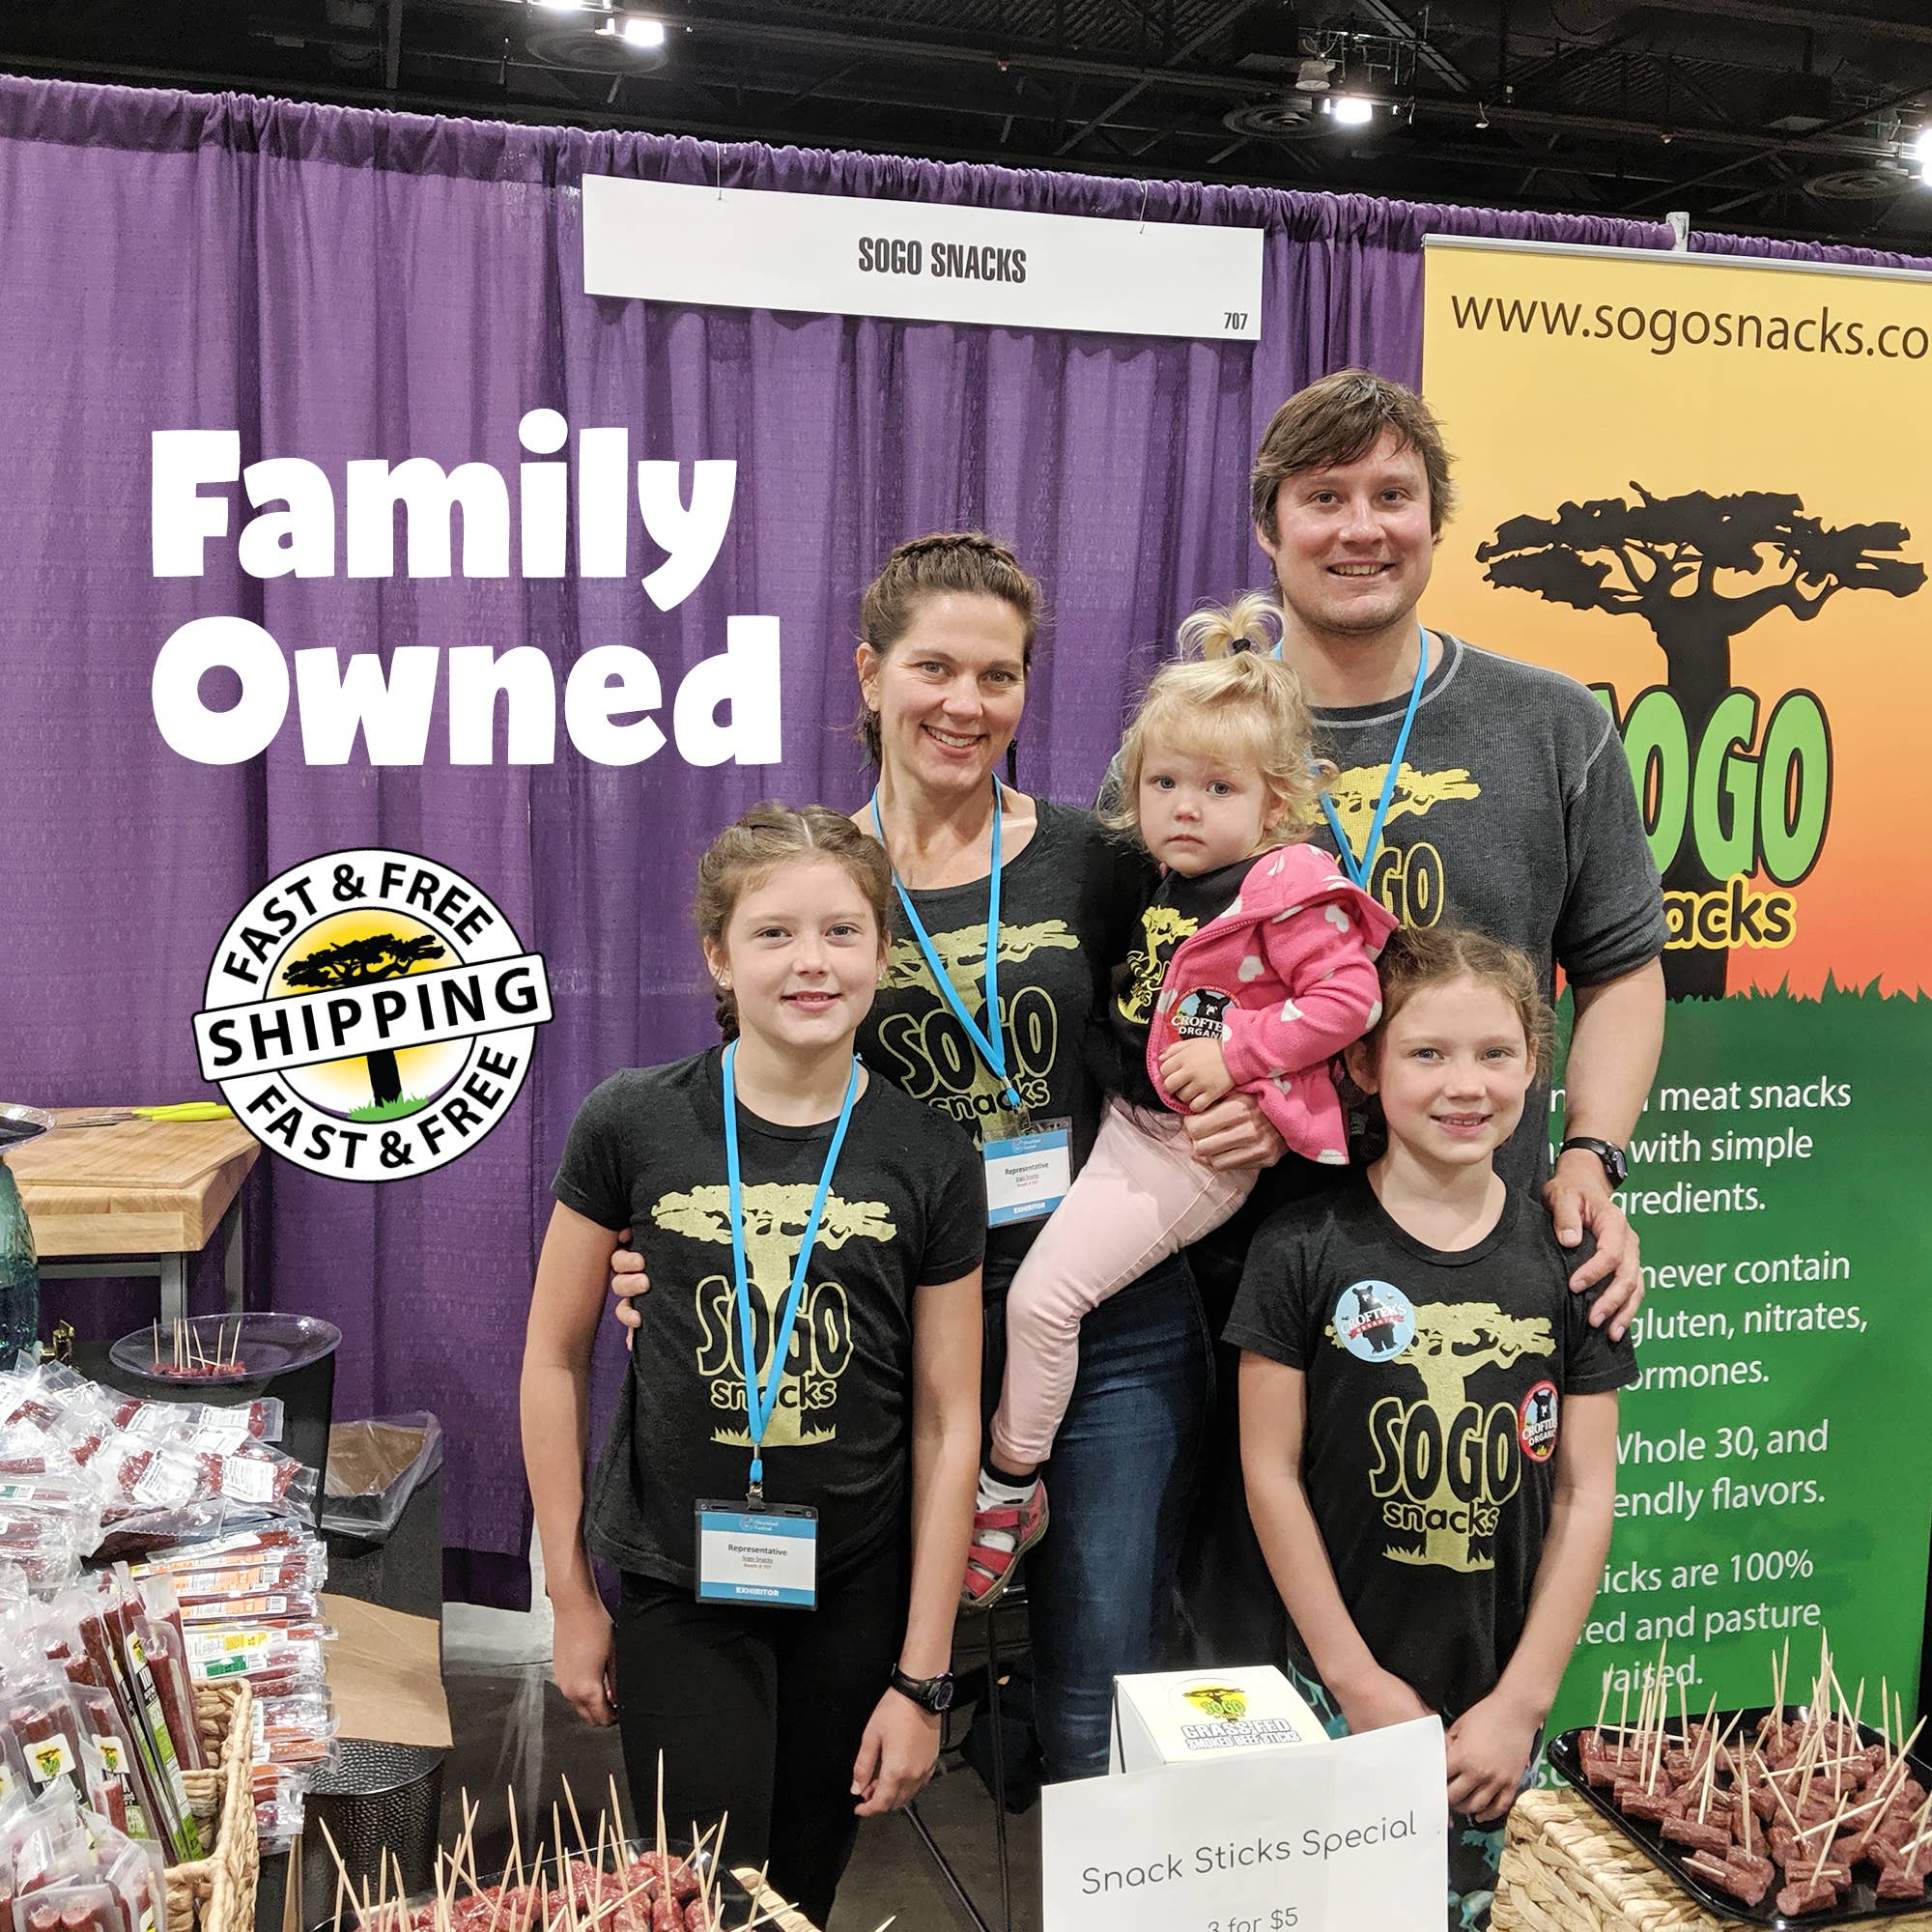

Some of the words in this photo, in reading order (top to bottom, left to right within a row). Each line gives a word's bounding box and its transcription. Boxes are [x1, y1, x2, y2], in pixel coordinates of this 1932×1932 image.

[858, 237, 923, 275] SOGO
[930, 242, 1027, 284] SNACKS
[1223, 312, 1248, 330] 707
[1451, 295, 1929, 359] www.sogosnacks.co
[1586, 682, 1833, 888] OGO
[1661, 1081, 1742, 1112] meat
[1749, 1075, 1852, 1109] snacks
[1630, 1130, 1701, 1164] with
[1711, 1127, 1814, 1167] simple
[1640, 1262, 1727, 1290] never
[1734, 1251, 1851, 1286] contain
[1631, 1308, 1735, 1349] gluten,
[1744, 1302, 1869, 1334] nitrates,
[1368, 1397, 1521, 1506] SOGO
[1715, 1426, 1759, 1461] 30,
[1766, 1419, 1829, 1454] and
[1712, 1477, 1826, 1511] flavors.
[1382, 1500, 1500, 1537] snacks
[727, 1544, 788, 1556] Representative
[1596, 1560, 1662, 1594] icks
[1670, 1562, 1719, 1589] are
[1730, 1548, 1814, 1583] 100%
[1635, 1605, 1695, 1640] and
[1704, 1603, 1821, 1642] pasture
[1181, 1721, 1251, 1739] GRASS
[1252, 1719, 1292, 1735] FED
[1185, 1736, 1235, 1750] SMOKED
[1082, 1856, 1183, 1894] Snack
[1195, 1837, 1291, 1873] Sticks
[1302, 1810, 1417, 1861] Special
[1270, 1907, 1298, 1931] $5
